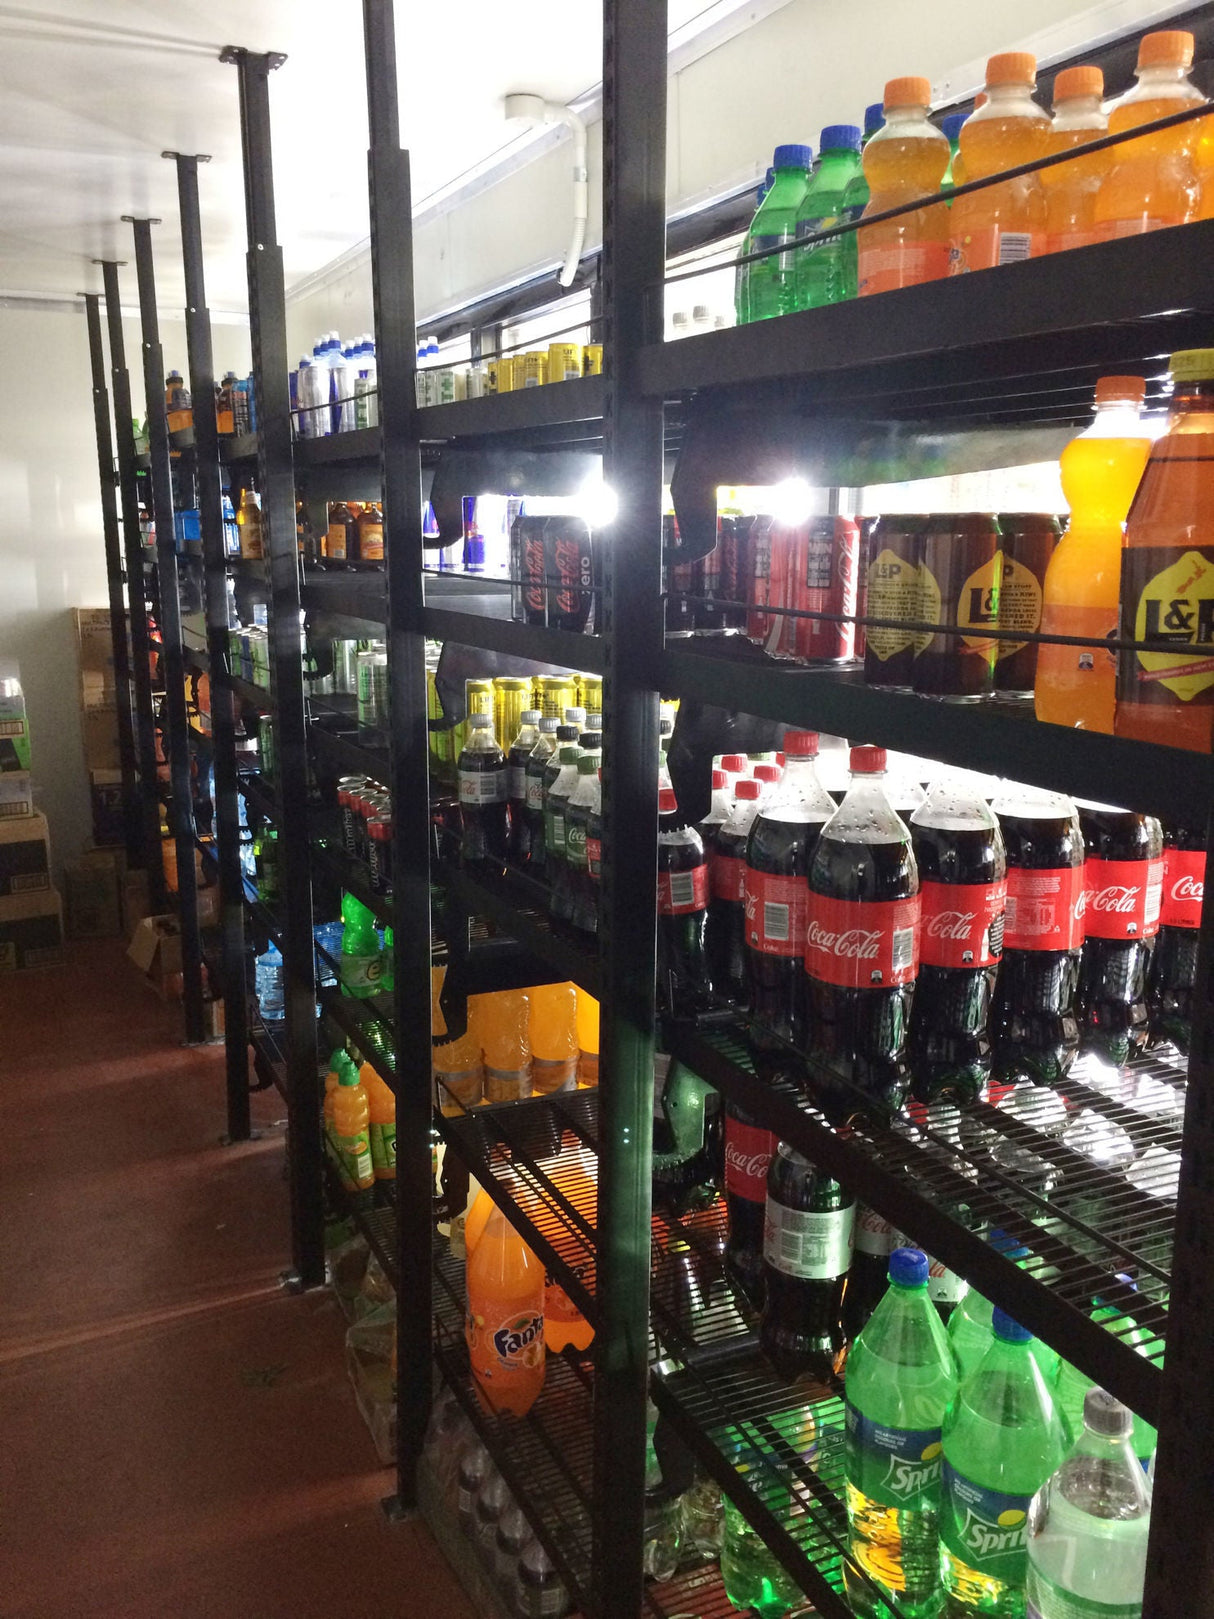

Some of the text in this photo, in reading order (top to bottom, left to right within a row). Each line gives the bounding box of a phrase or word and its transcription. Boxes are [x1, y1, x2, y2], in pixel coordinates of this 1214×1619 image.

[807, 920, 885, 959] Coca-Cola
[725, 1142, 769, 1179] Coca-Co
[890, 1461, 940, 1494] Spri
